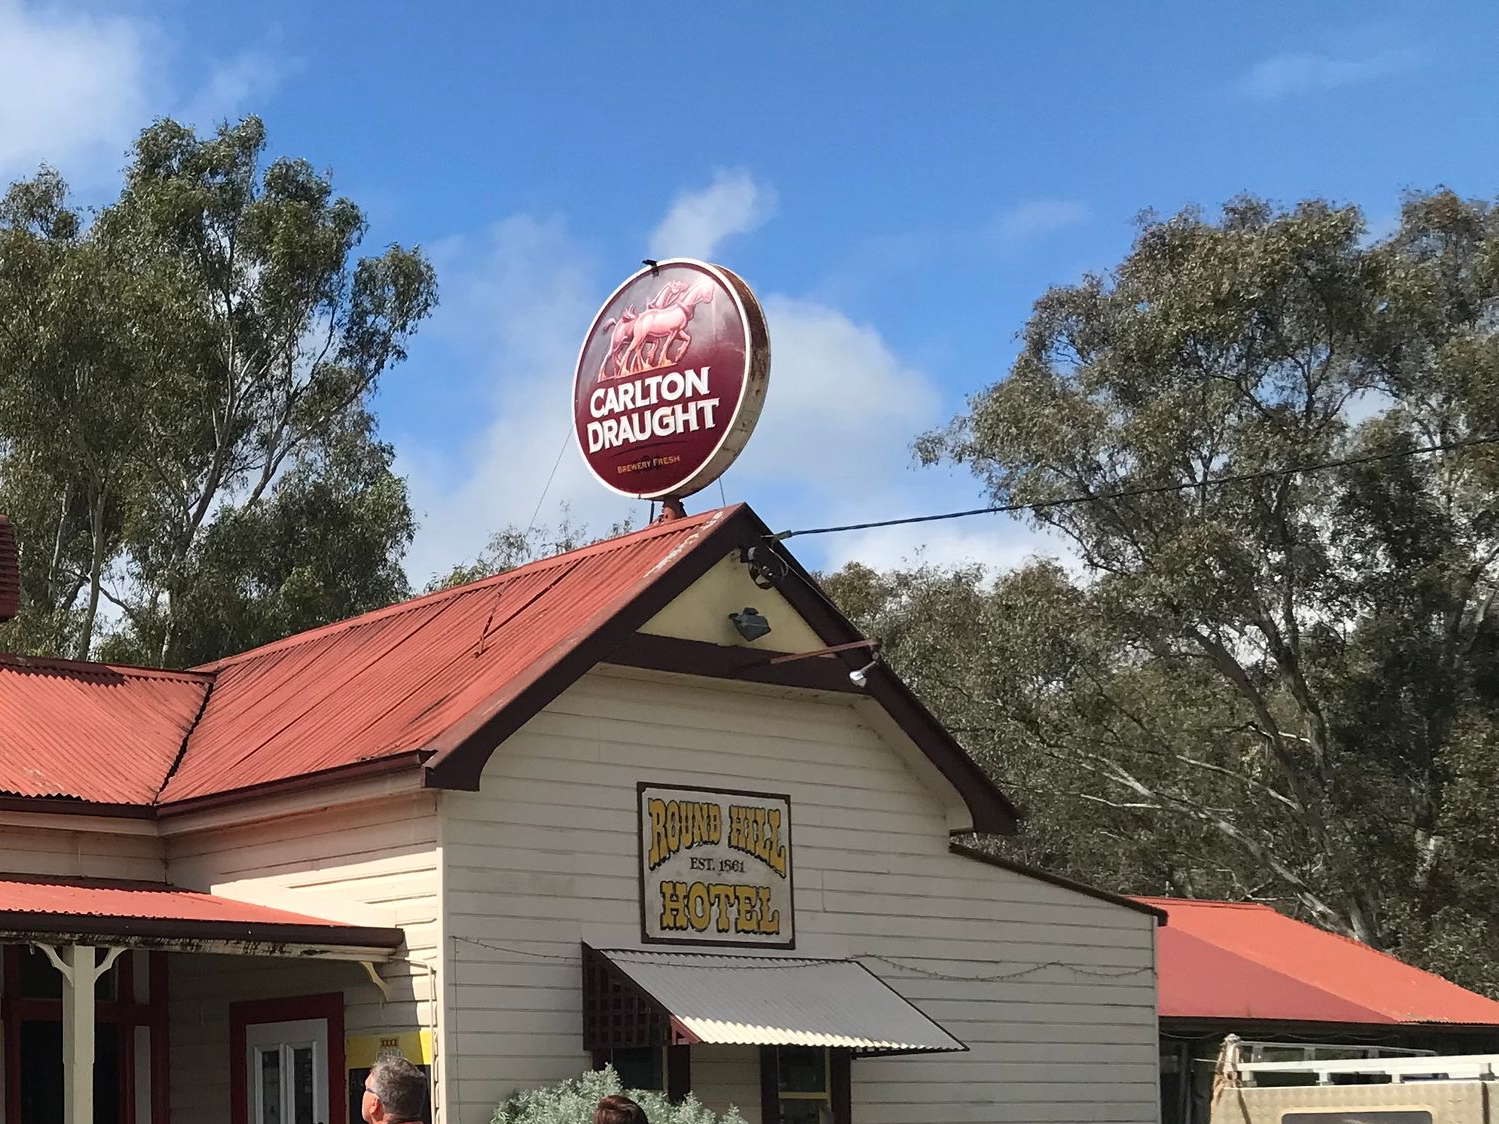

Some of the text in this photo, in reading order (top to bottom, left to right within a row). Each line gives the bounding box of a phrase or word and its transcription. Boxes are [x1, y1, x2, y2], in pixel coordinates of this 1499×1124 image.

[590, 366, 710, 418] CARLTON
[587, 398, 720, 453] DRAUGHT
[617, 455, 680, 474] BREWERY FRESH
[648, 798, 787, 879] ROUND HILL
[689, 857, 745, 873] EST. 1861
[660, 881, 780, 935] HOTEL
